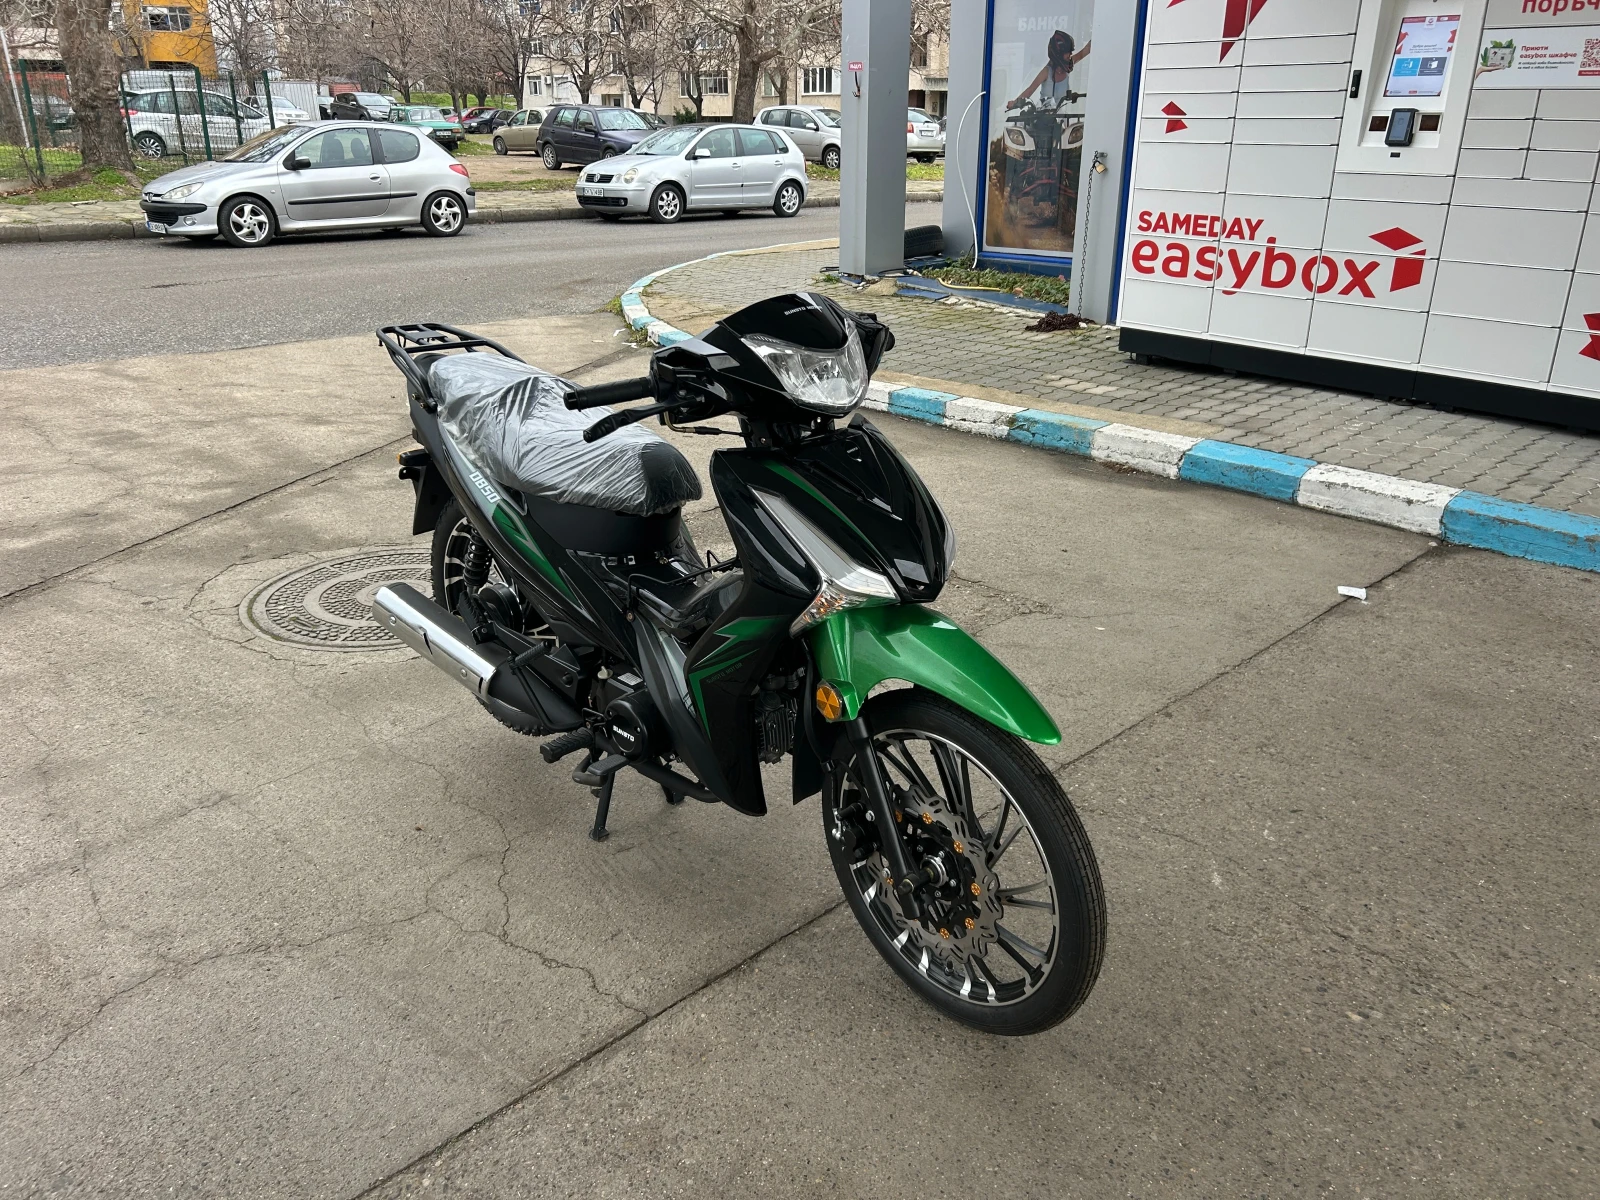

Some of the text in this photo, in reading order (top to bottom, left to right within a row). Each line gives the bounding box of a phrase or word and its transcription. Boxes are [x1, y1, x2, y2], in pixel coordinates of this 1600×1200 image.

[1017, 15, 1069, 32] БАНКЯ
[1137, 210, 1264, 241] SAMEDAY
[1132, 237, 1381, 299] easybox
[612, 724, 635, 742] SUNSTO
